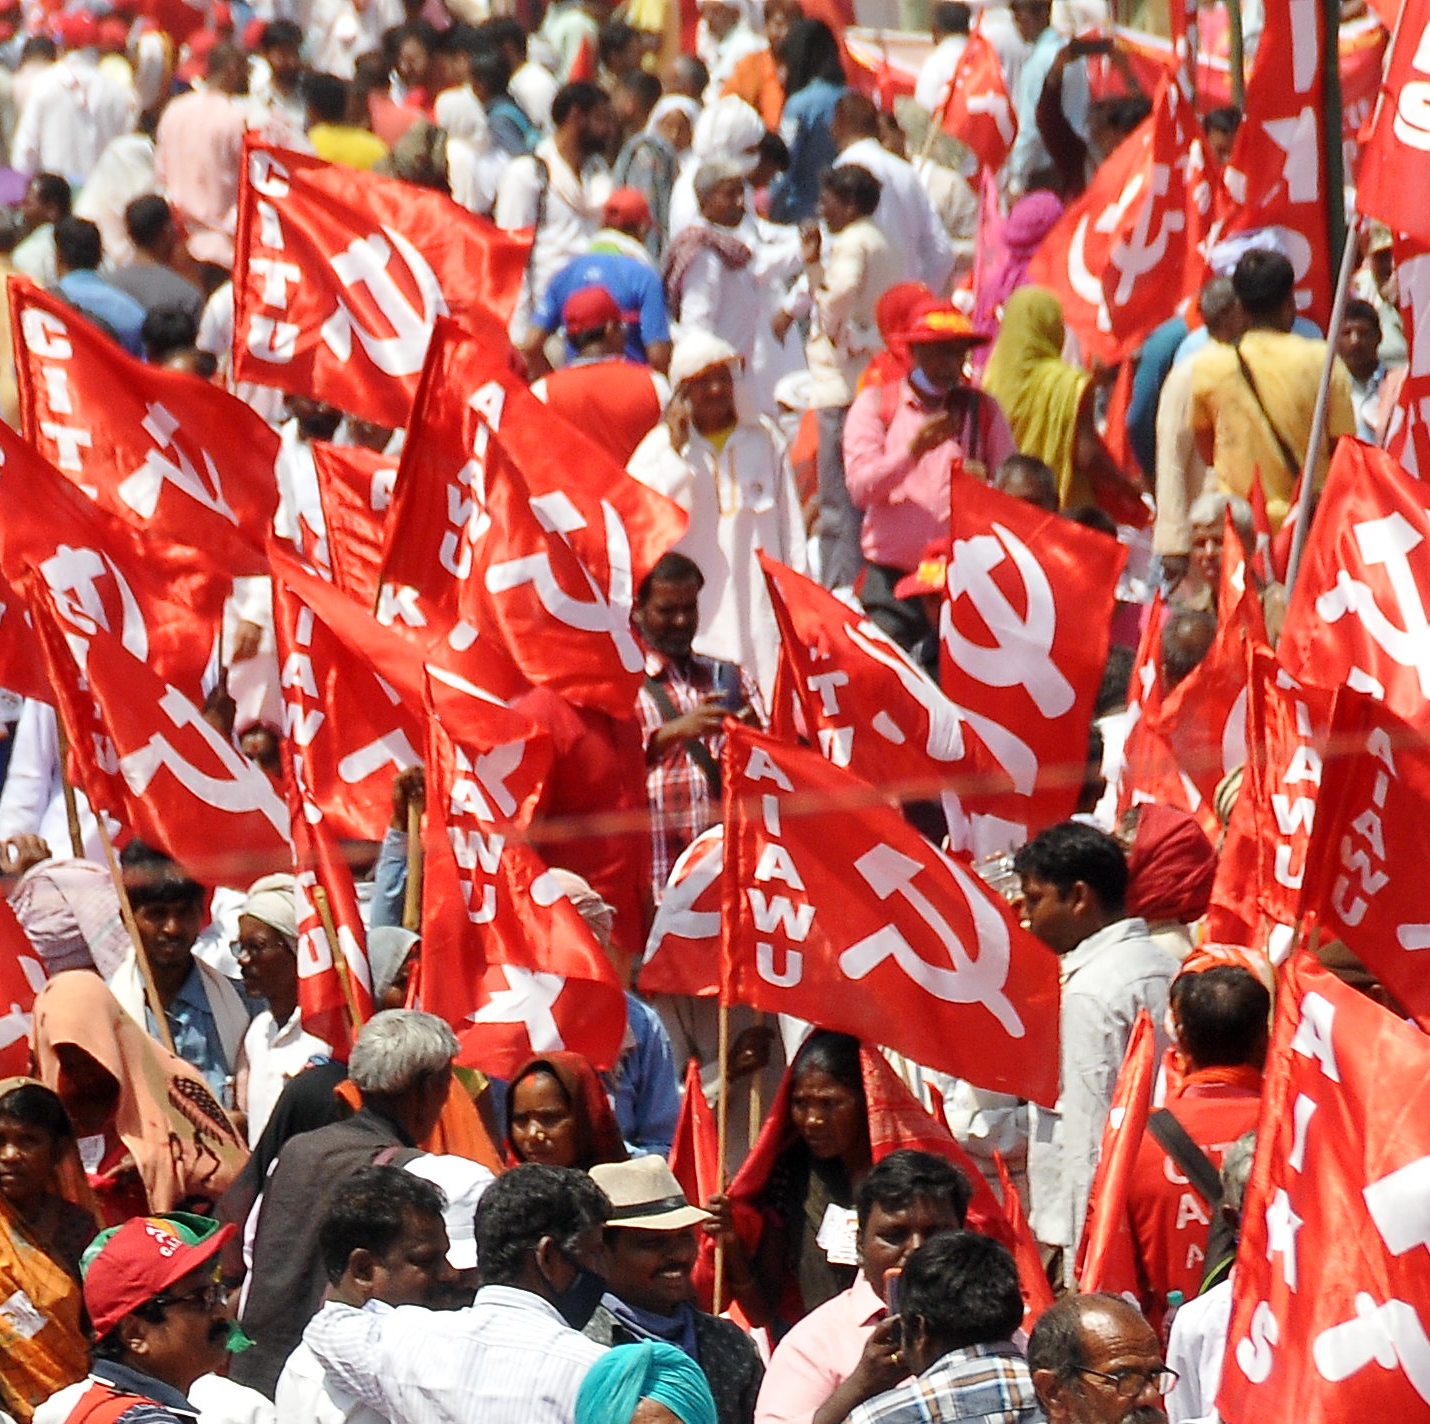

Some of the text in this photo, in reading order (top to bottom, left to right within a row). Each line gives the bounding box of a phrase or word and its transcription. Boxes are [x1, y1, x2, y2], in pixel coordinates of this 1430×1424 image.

[246, 151, 302, 364] CITU
[22, 308, 97, 499] CIT
[745, 747, 816, 990] AIAWU
[1331, 732, 1397, 927] AIAWU
